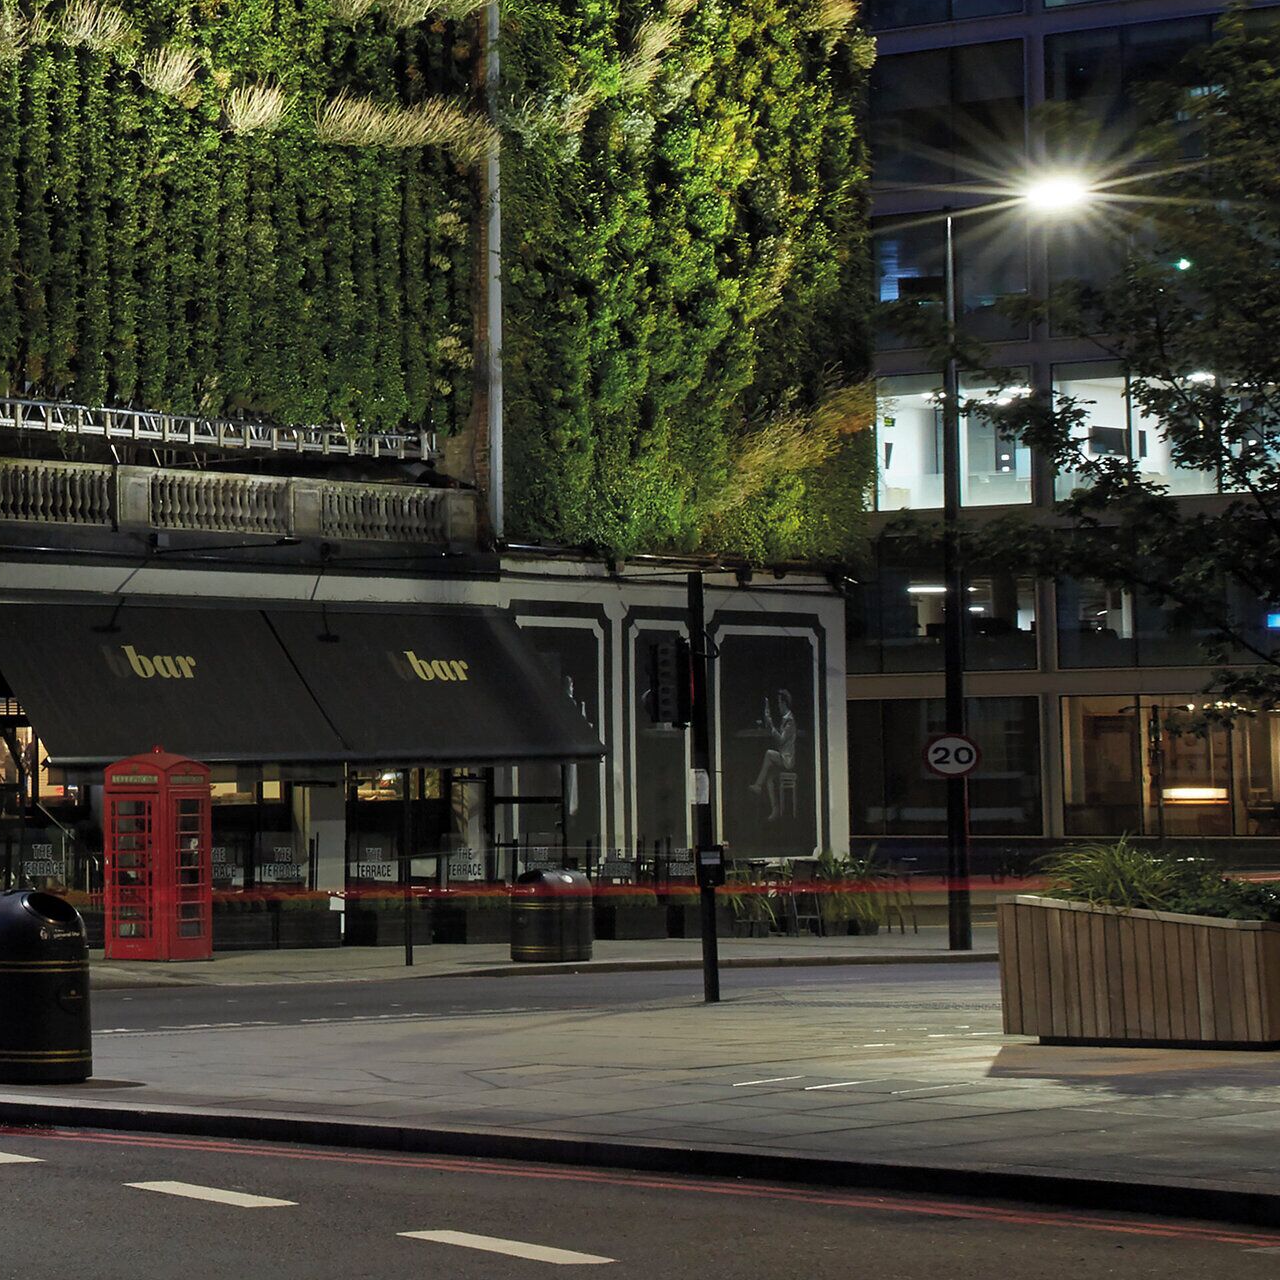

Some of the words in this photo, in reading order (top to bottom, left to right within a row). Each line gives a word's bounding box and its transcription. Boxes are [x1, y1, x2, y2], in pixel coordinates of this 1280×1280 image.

[932, 747, 974, 765] 20
[32, 843, 52, 859] THE
[273, 846, 292, 862] THE
[458, 848, 473, 860] THE
[261, 863, 303, 879] TERRACE
[358, 864, 392, 878] TERRACE
[448, 863, 482, 877] TERRACE
